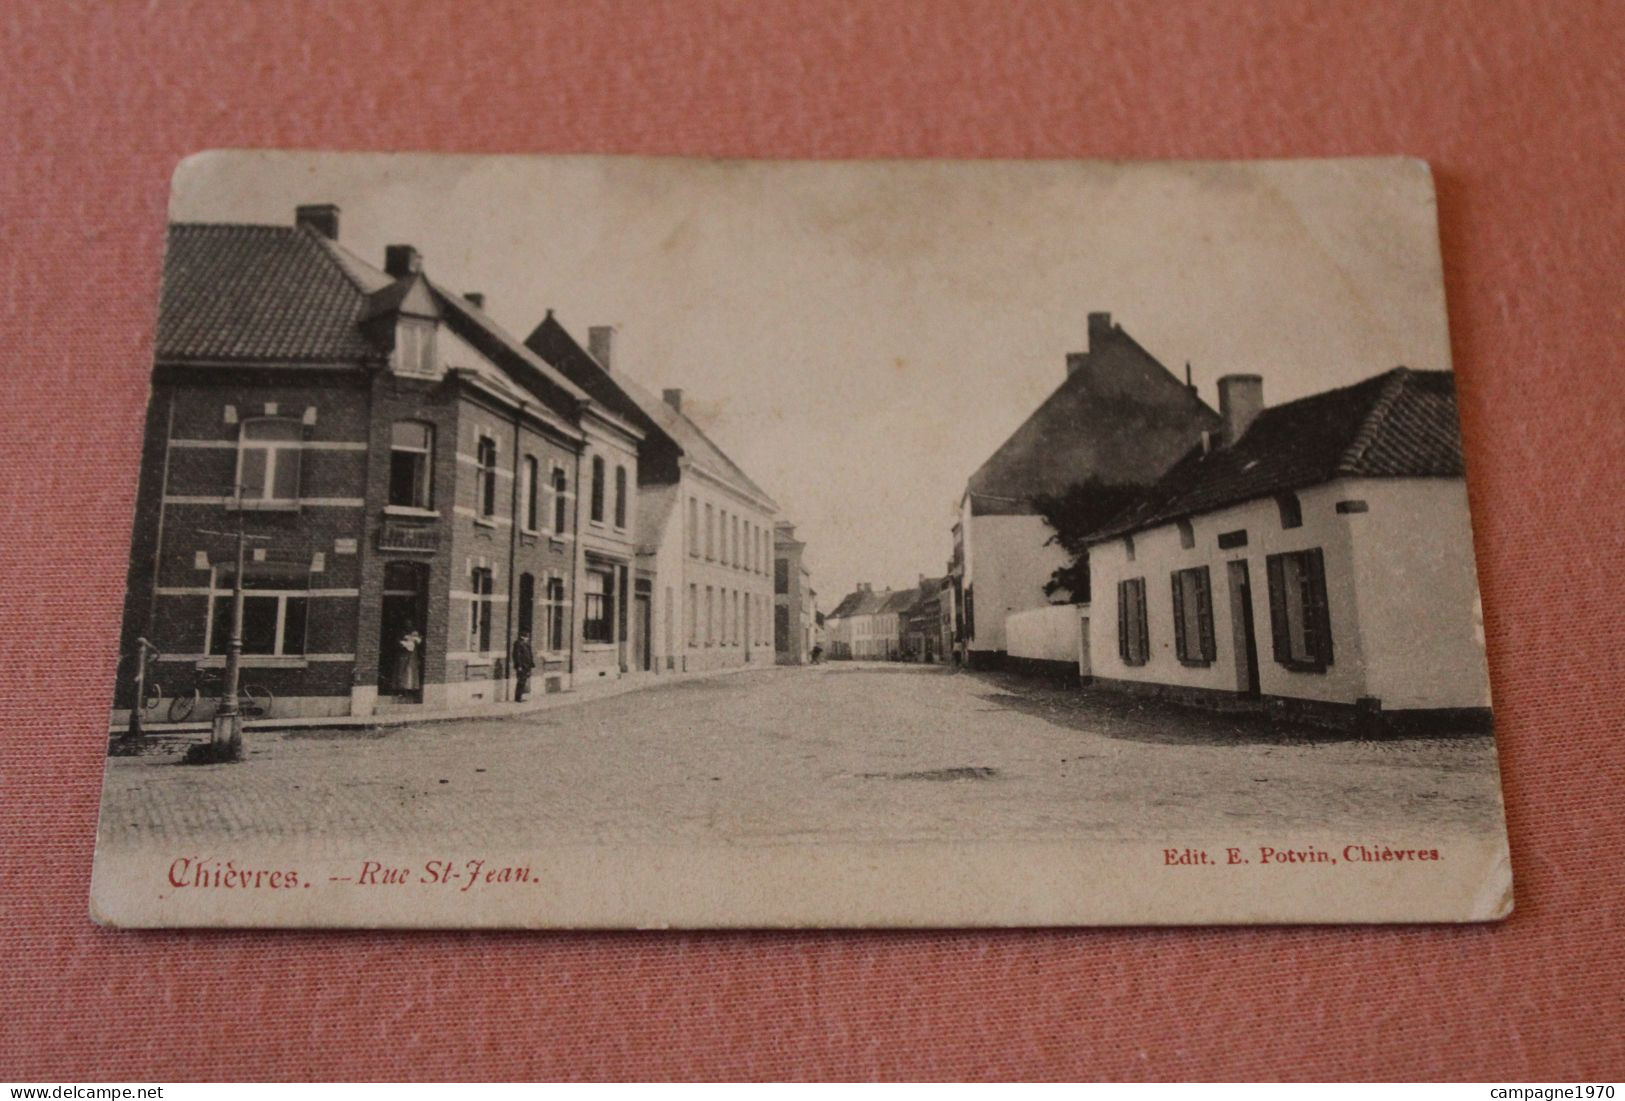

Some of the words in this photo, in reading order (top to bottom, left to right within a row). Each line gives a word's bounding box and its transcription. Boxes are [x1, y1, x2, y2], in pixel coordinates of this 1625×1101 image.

[1163, 849, 1216, 866] Edit.
[1226, 848, 1249, 865] E.
[1259, 845, 1338, 866] Potvin,
[167, 855, 311, 889] Chièvres.
[420, 858, 541, 892] St-Jean.
